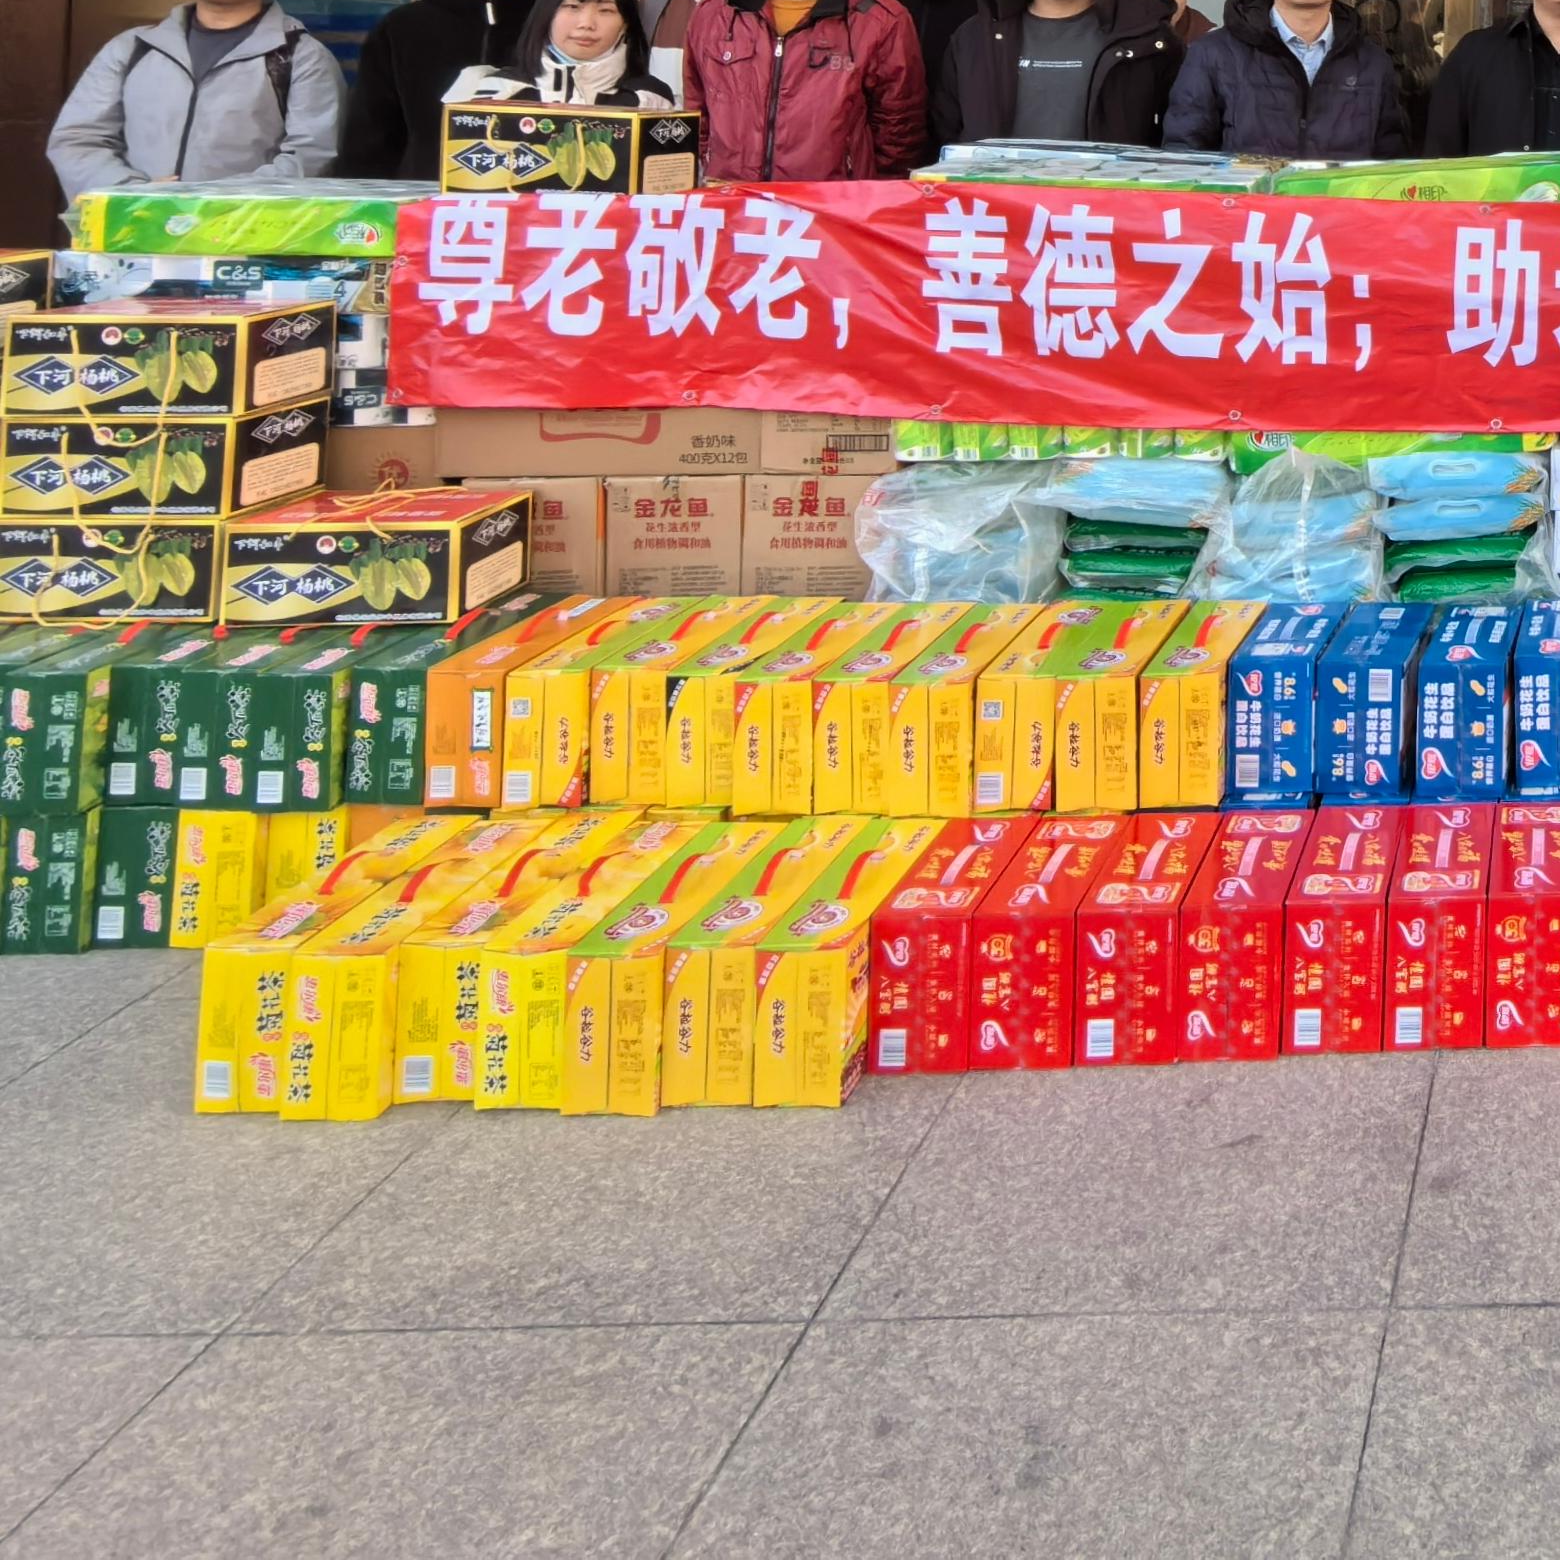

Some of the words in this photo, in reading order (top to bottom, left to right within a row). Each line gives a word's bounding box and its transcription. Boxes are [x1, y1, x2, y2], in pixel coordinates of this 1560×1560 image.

[216, 265, 263, 282] C&S
[418, 190, 850, 350] 尊老敬老，
[921, 197, 1373, 371] 善德之始；
[691, 435, 735, 449] 香奶味
[635, 496, 712, 518] 金龙鱼
[1236, 700, 1249, 748] 蛋白饮品
[1250, 700, 1262, 748] 牛奶花生
[1423, 683, 1439, 739] 牛奶花生
[1440, 683, 1455, 739] 蛋白饮品
[1519, 675, 1534, 731] 牛奶花生
[1536, 674, 1551, 731] 蛋白饮品
[559, 716, 570, 764] 谷粒谷力
[603, 712, 615, 759] 谷粒谷力
[681, 716, 692, 763] 谷粒谷力
[748, 725, 760, 771] 谷粒谷力
[827, 720, 839, 768] 谷粒谷力
[904, 724, 914, 773] 谷粒谷力
[1030, 721, 1042, 768] 谷粒谷力
[1069, 721, 1081, 768] 谷粒谷力
[1154, 718, 1164, 766] 谷粒谷力
[1366, 708, 1378, 755] 牛奶花生
[1379, 708, 1392, 756] 蛋白饮品
[317, 818, 338, 869] 菊花茶
[179, 882, 201, 933] 菊花茶
[257, 971, 285, 1032] 菊花茶
[455, 962, 480, 1023] 菊花茶
[580, 1005, 593, 1062] 谷粒谷力
[680, 998, 693, 1053] 谷粒谷力
[772, 999, 785, 1054] 谷粒谷力
[287, 1040, 315, 1102] 菊花茶
[485, 1035, 508, 1096] 菊花茶
